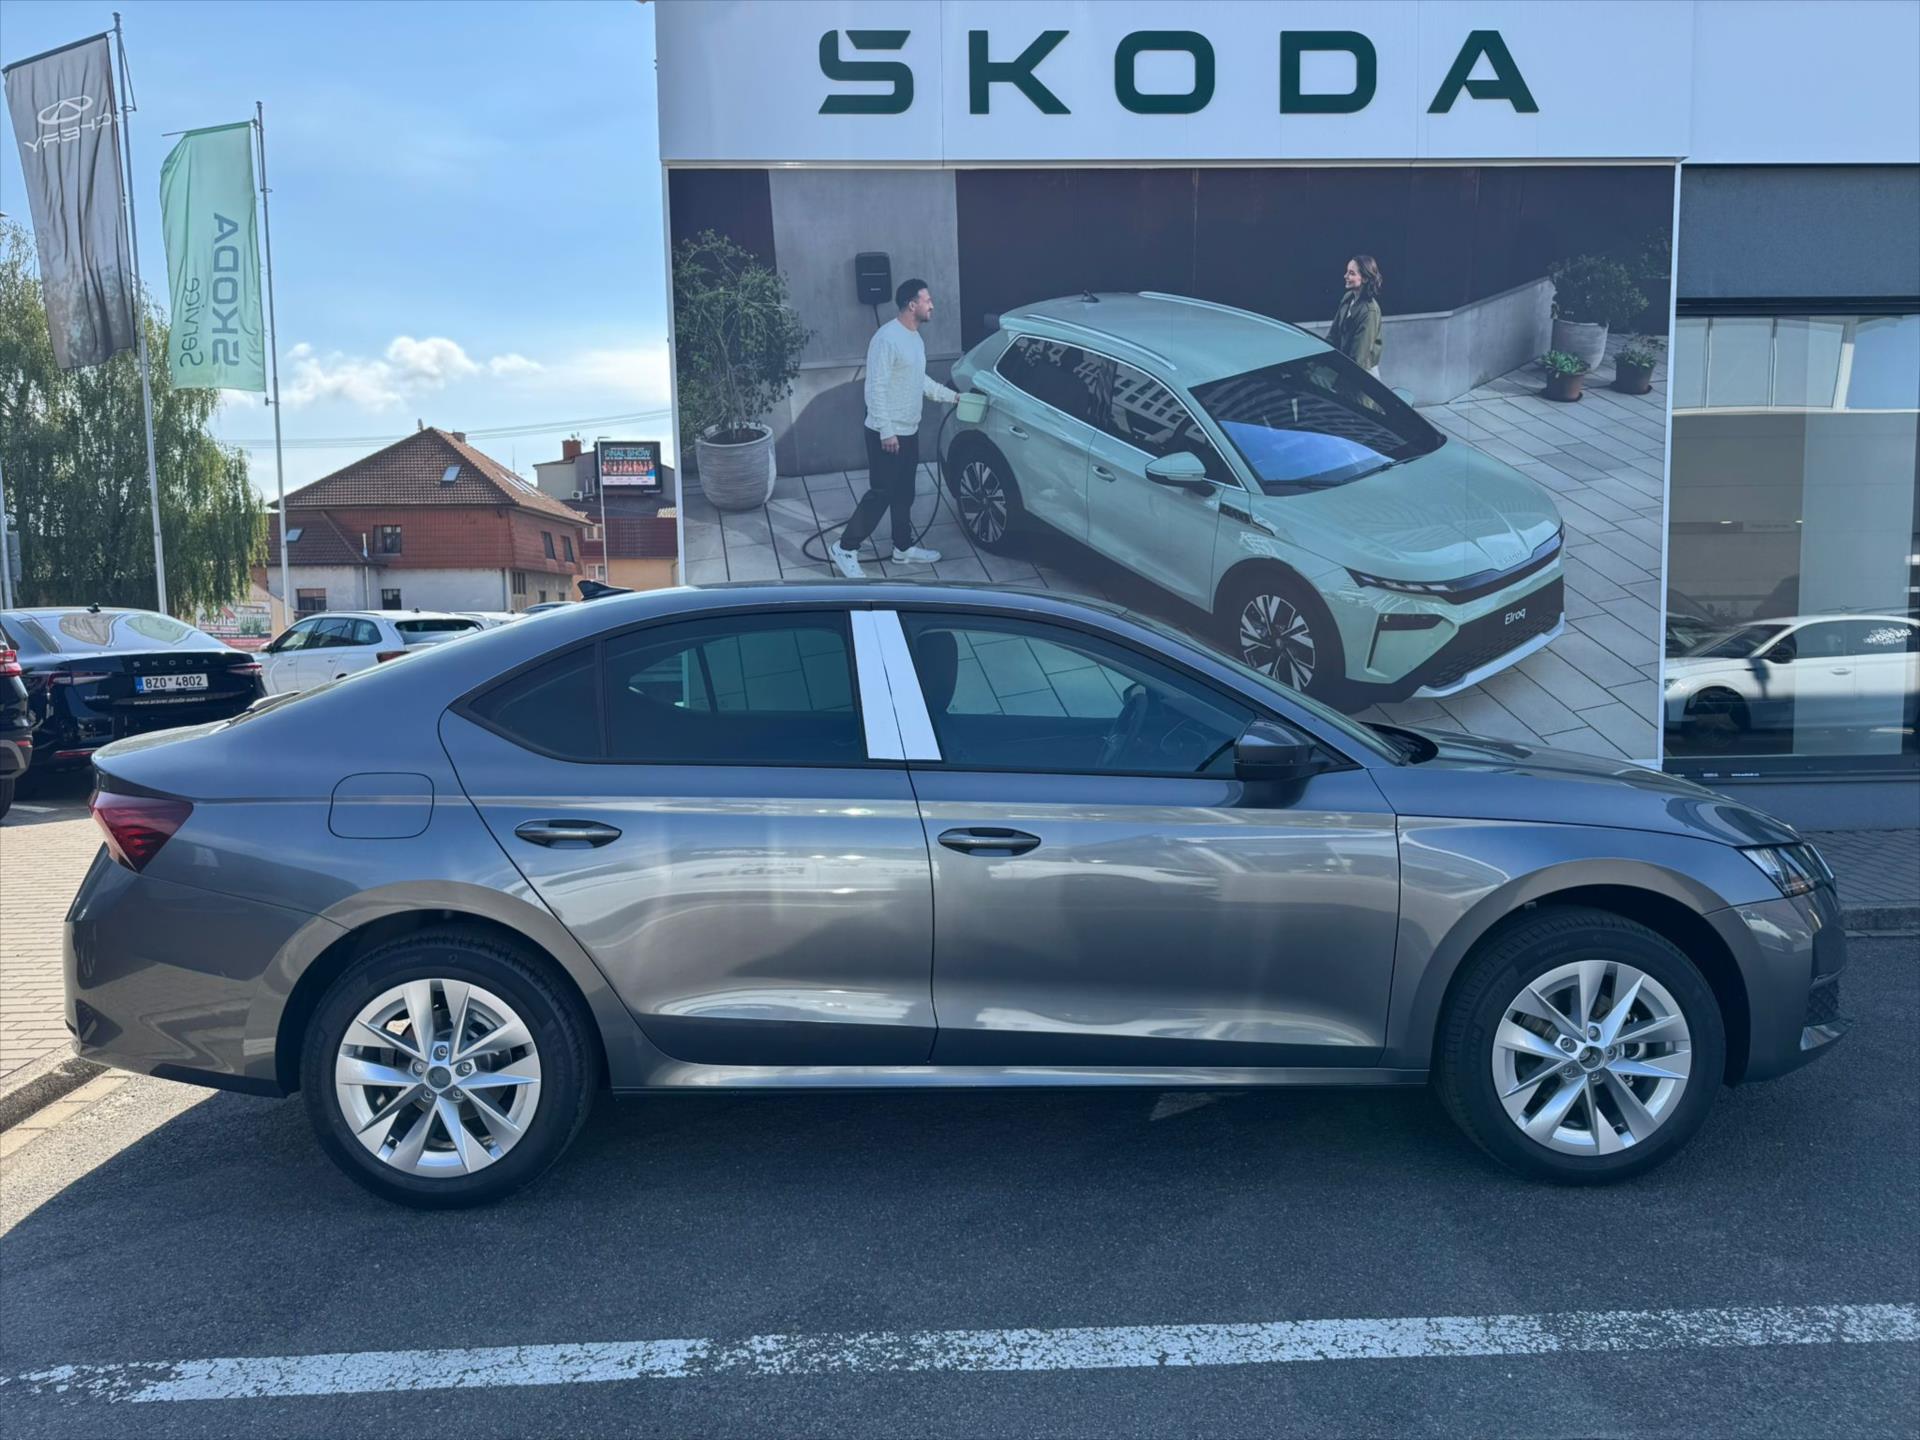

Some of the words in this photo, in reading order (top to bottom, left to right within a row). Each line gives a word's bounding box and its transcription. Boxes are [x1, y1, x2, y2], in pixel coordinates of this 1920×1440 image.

[818, 30, 1540, 115] SKODA
[1504, 607, 1526, 625] Elroq
[133, 659, 209, 668] SKODA
[175, 676, 203, 688] 4802
